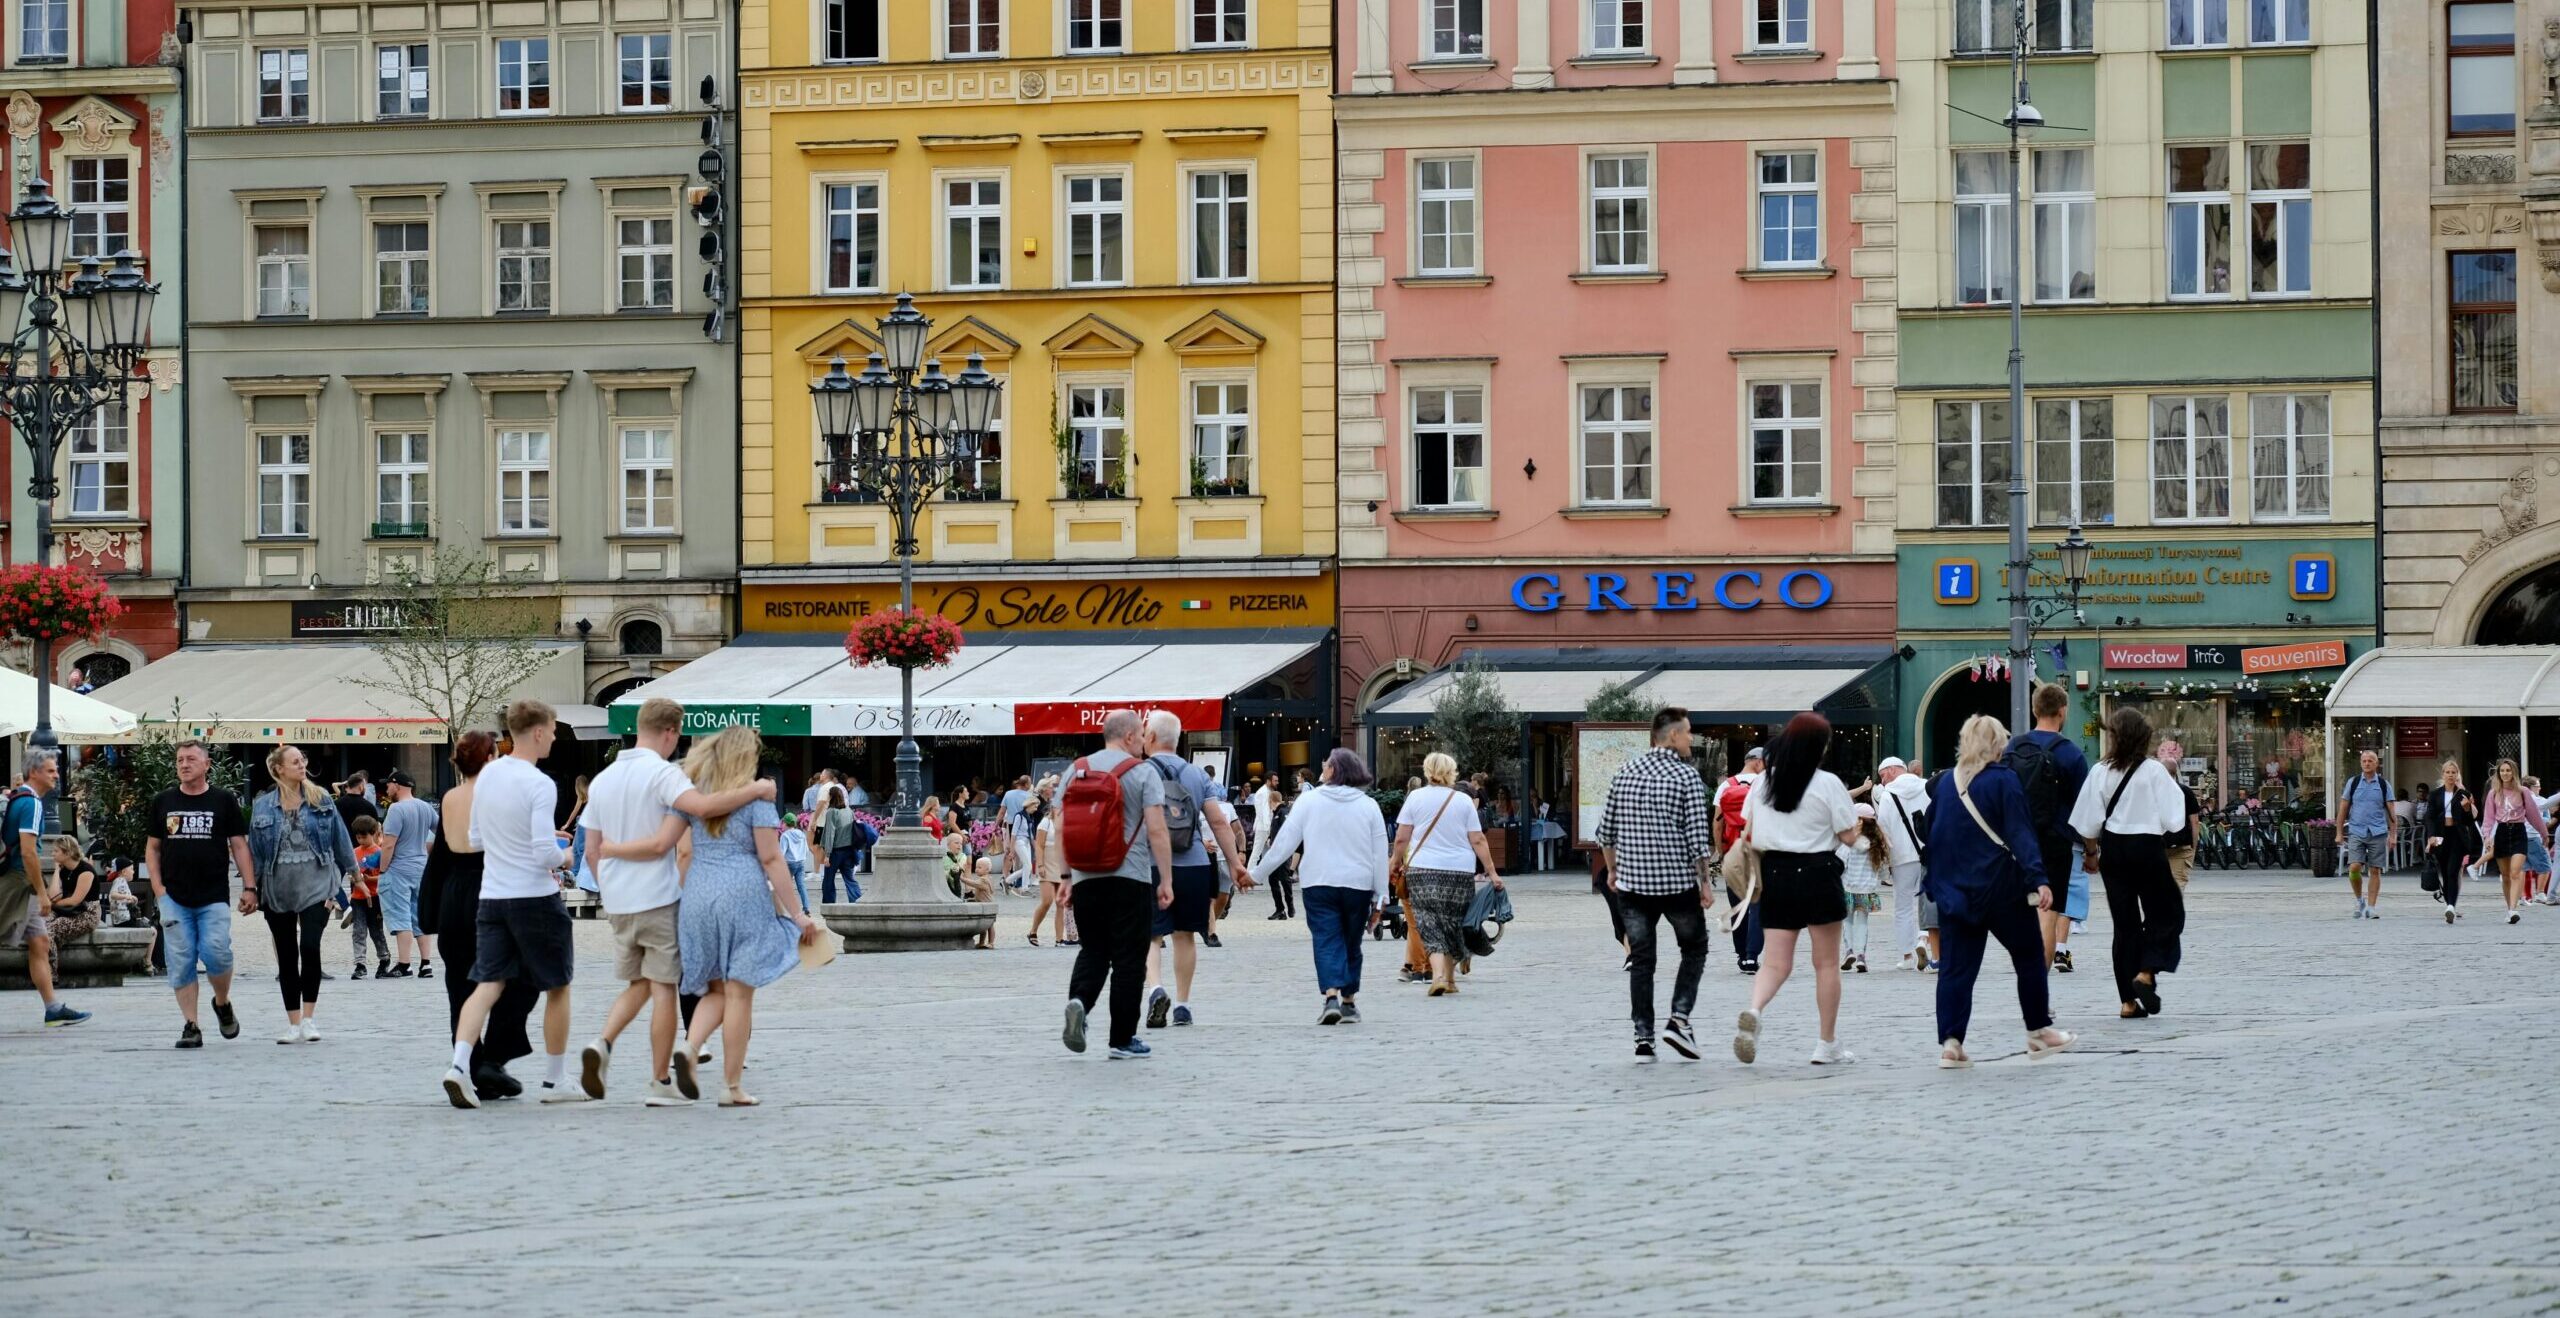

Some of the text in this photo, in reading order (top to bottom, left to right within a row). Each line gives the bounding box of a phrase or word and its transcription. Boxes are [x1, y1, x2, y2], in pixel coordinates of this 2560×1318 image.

[2090, 548, 2154, 562] nformacji
[2084, 566, 2196, 586] nformation
[2203, 566, 2271, 586] Centre
[1510, 569, 1835, 612] GRECO
[765, 601, 870, 618] RISTORANTE
[985, 586, 1070, 629] Sole
[1076, 583, 1164, 626] Mio
[1229, 595, 1308, 612] PIZZERIA
[2110, 649, 2180, 664] Wrocław
[2194, 648, 2225, 664] info
[2249, 646, 2338, 669] souvenirs
[681, 712, 761, 728] TORANTE
[926, 708, 970, 730] Mio
[220, 726, 255, 740] Pasta
[182, 816, 214, 828] 1963
